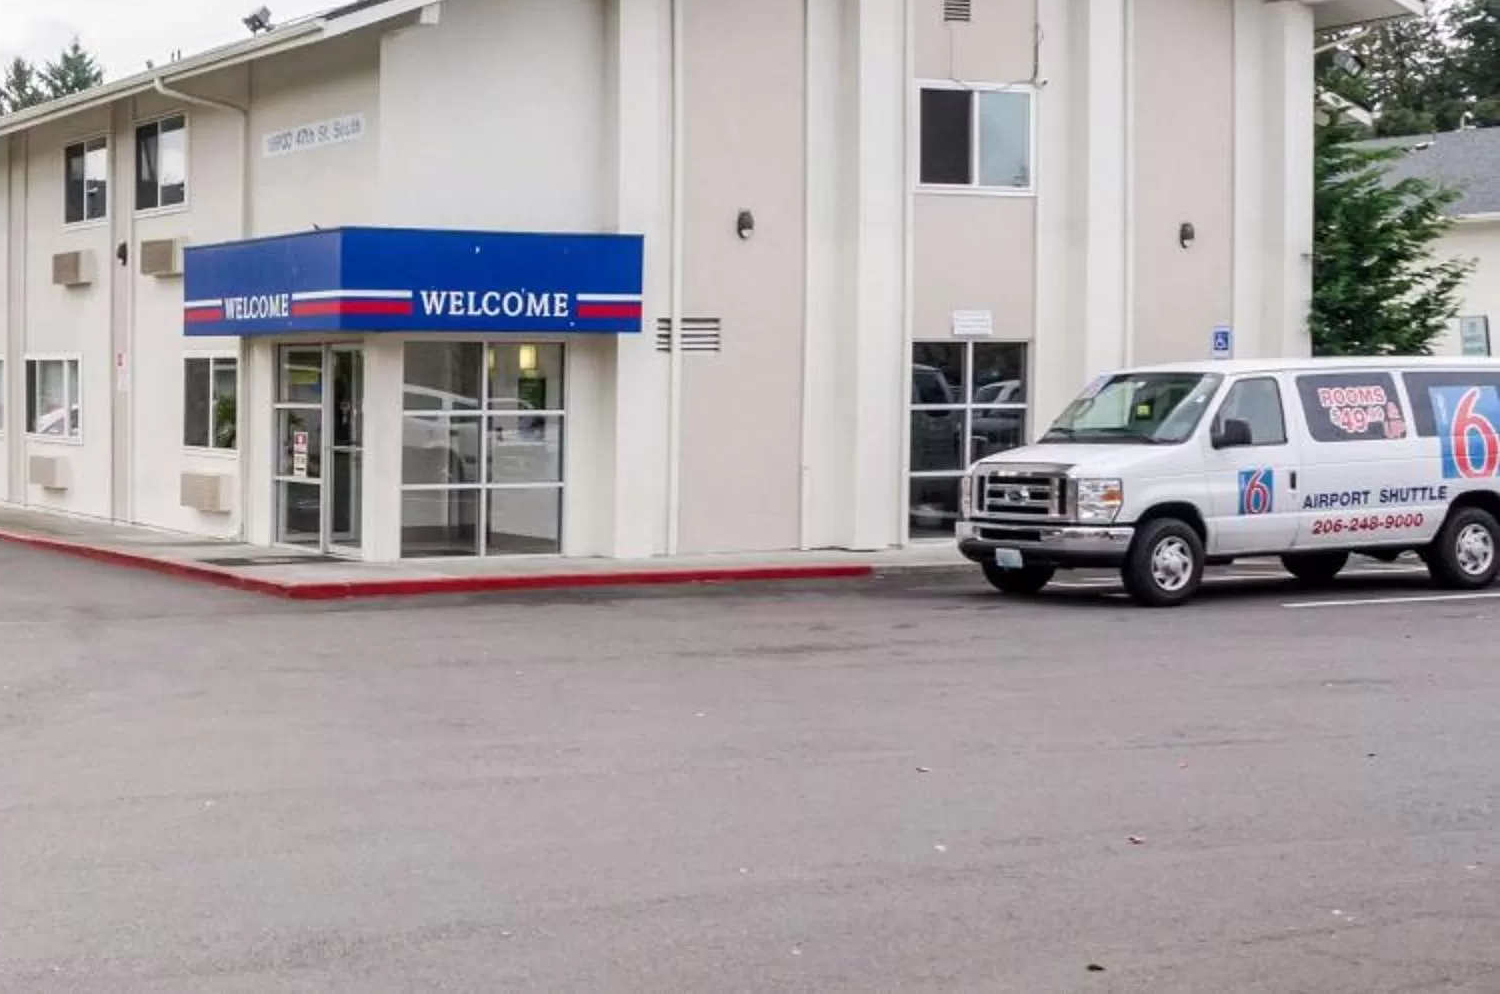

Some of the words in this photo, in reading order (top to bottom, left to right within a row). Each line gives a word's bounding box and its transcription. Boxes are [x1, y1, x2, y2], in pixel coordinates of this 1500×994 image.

[224, 294, 289, 320] WELCOME
[419, 290, 570, 318] WELCOME
[1318, 386, 1387, 407] ROOMS
[1452, 387, 1500, 478] 6
[1244, 464, 1270, 515] 6
[1302, 490, 1371, 509] AIRPORT
[1379, 485, 1448, 504] SHUTTLE
[1312, 512, 1424, 535] 206-248-9000
